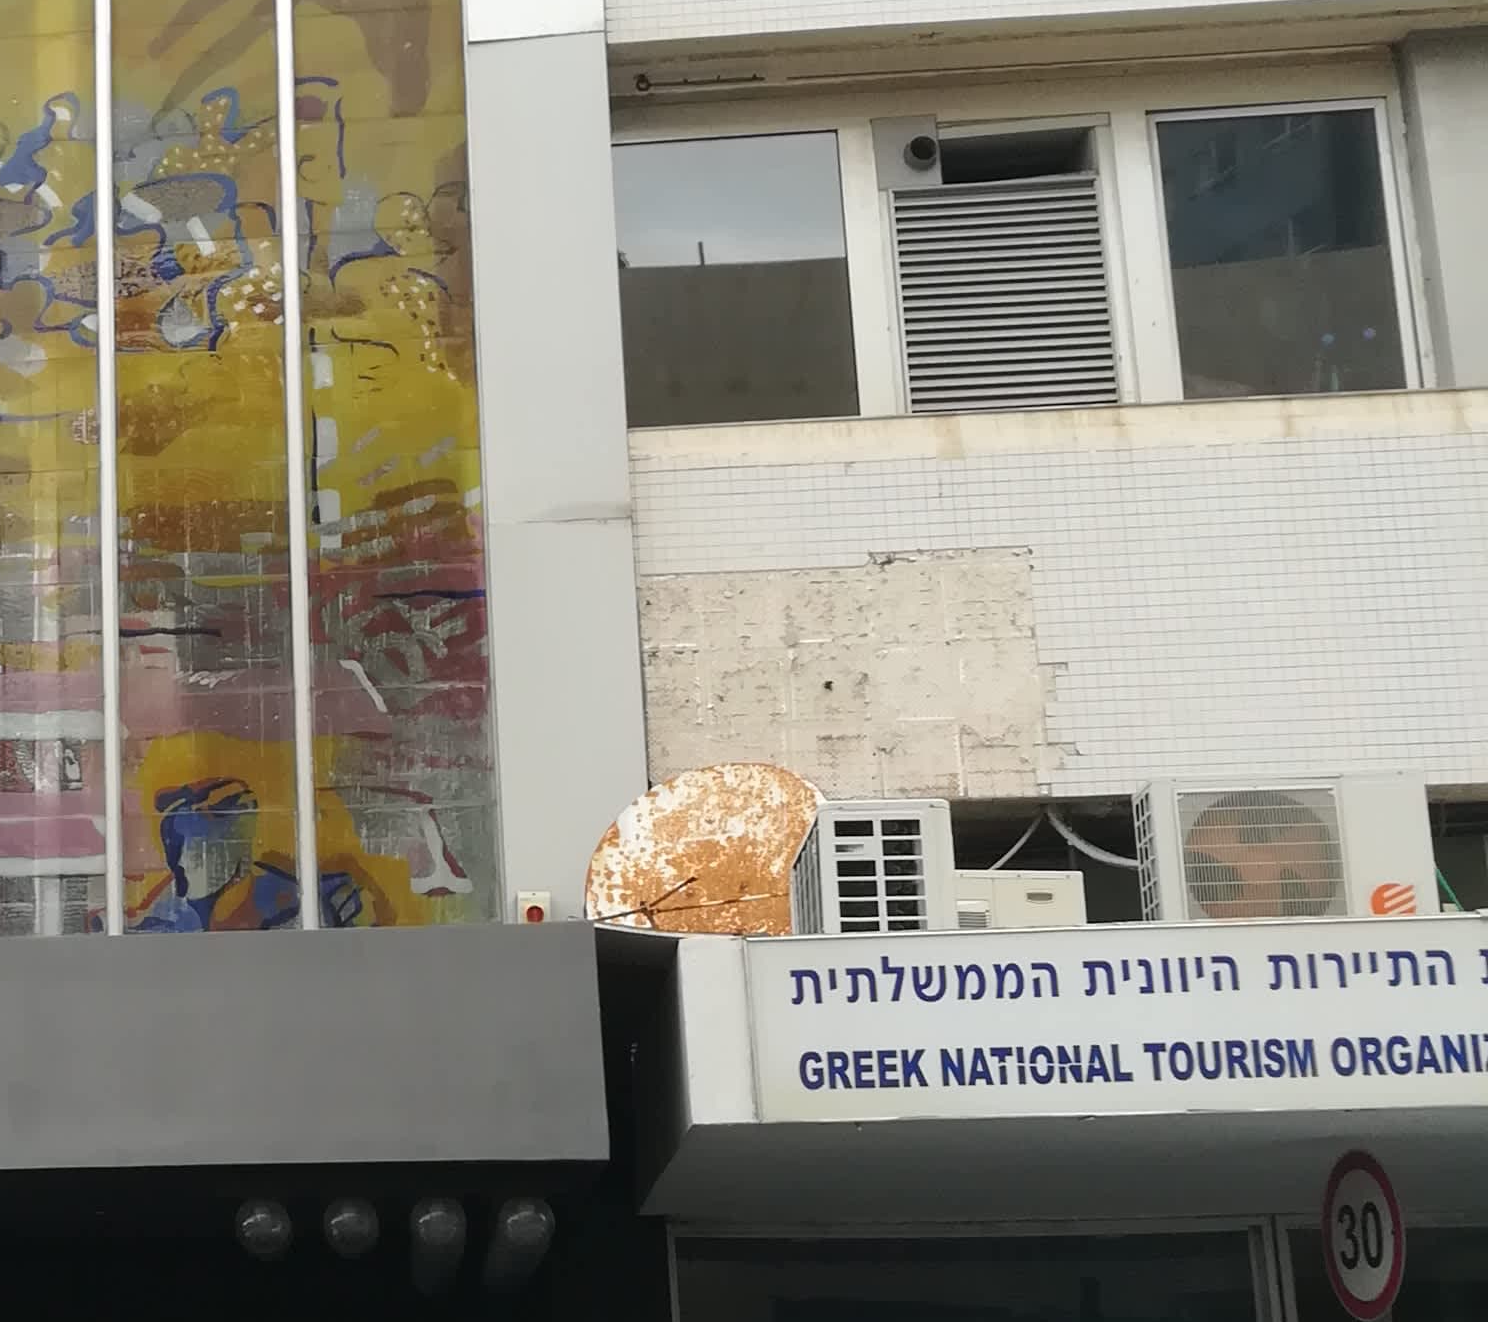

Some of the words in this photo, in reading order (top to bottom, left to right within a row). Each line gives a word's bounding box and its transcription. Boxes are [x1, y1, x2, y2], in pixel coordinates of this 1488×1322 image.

[791, 956, 1058, 1005] הממשלתית
[1082, 955, 1238, 997] היוונית
[1268, 950, 1455, 990] התיירות
[798, 1049, 927, 1089] GREEK
[939, 1044, 1133, 1086] NATIONAL
[1143, 1038, 1316, 1080] TOURISM
[1329, 1034, 1488, 1076] ORGANI
[1337, 1201, 1384, 1270] 30
